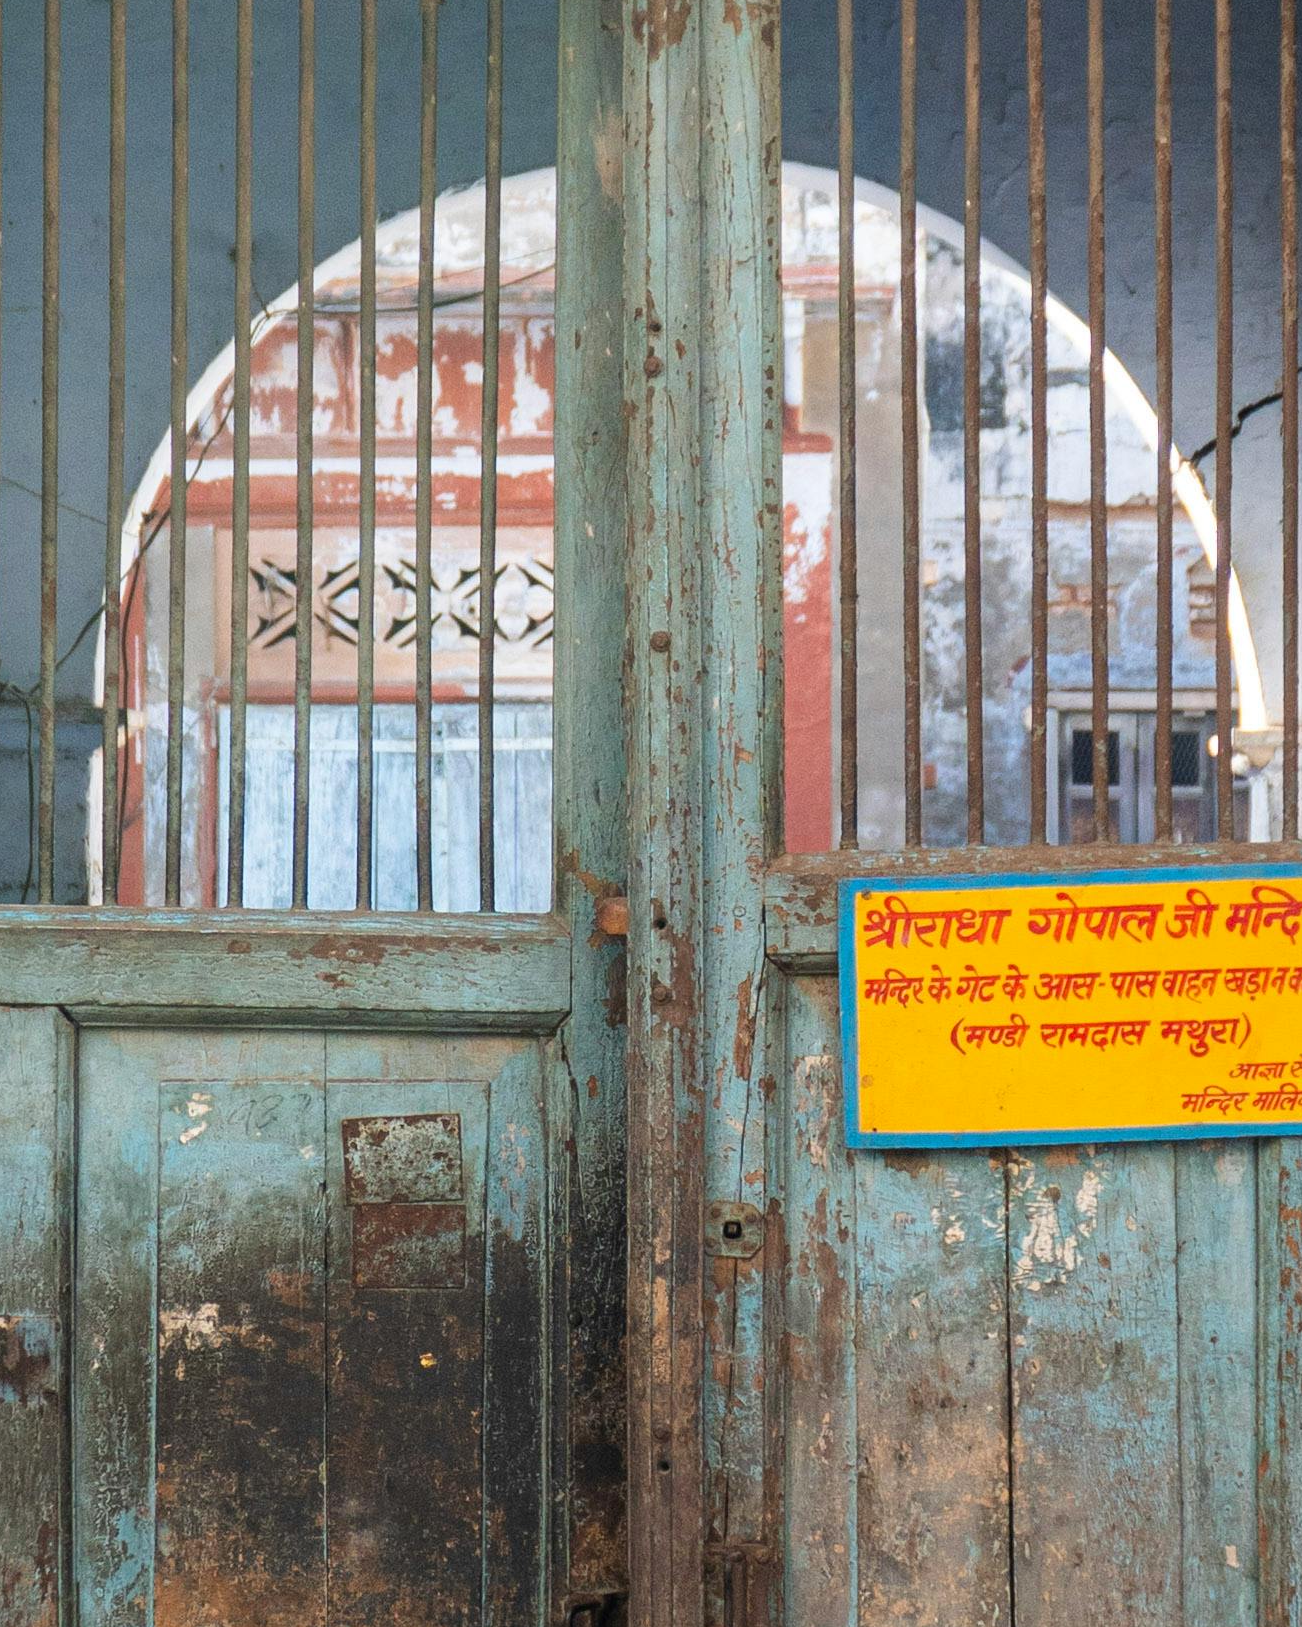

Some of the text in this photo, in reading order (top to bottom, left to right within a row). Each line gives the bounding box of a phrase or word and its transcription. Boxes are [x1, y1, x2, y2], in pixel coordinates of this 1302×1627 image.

[1027, 892, 1164, 948] गोपाल
[1165, 888, 1219, 939] जी
[864, 968, 924, 1008] मन्दिर
[928, 964, 952, 1005] के
[956, 964, 1001, 1004] गेट
[1002, 964, 1029, 1004] के
[1162, 969, 1222, 1004] वाहन
[950, 1012, 1253, 1057] (मण्डी रामदास मथुरा)
[1229, 1061, 1288, 1082] आज्ञा
[1180, 1085, 1249, 1115] मन्दिर
